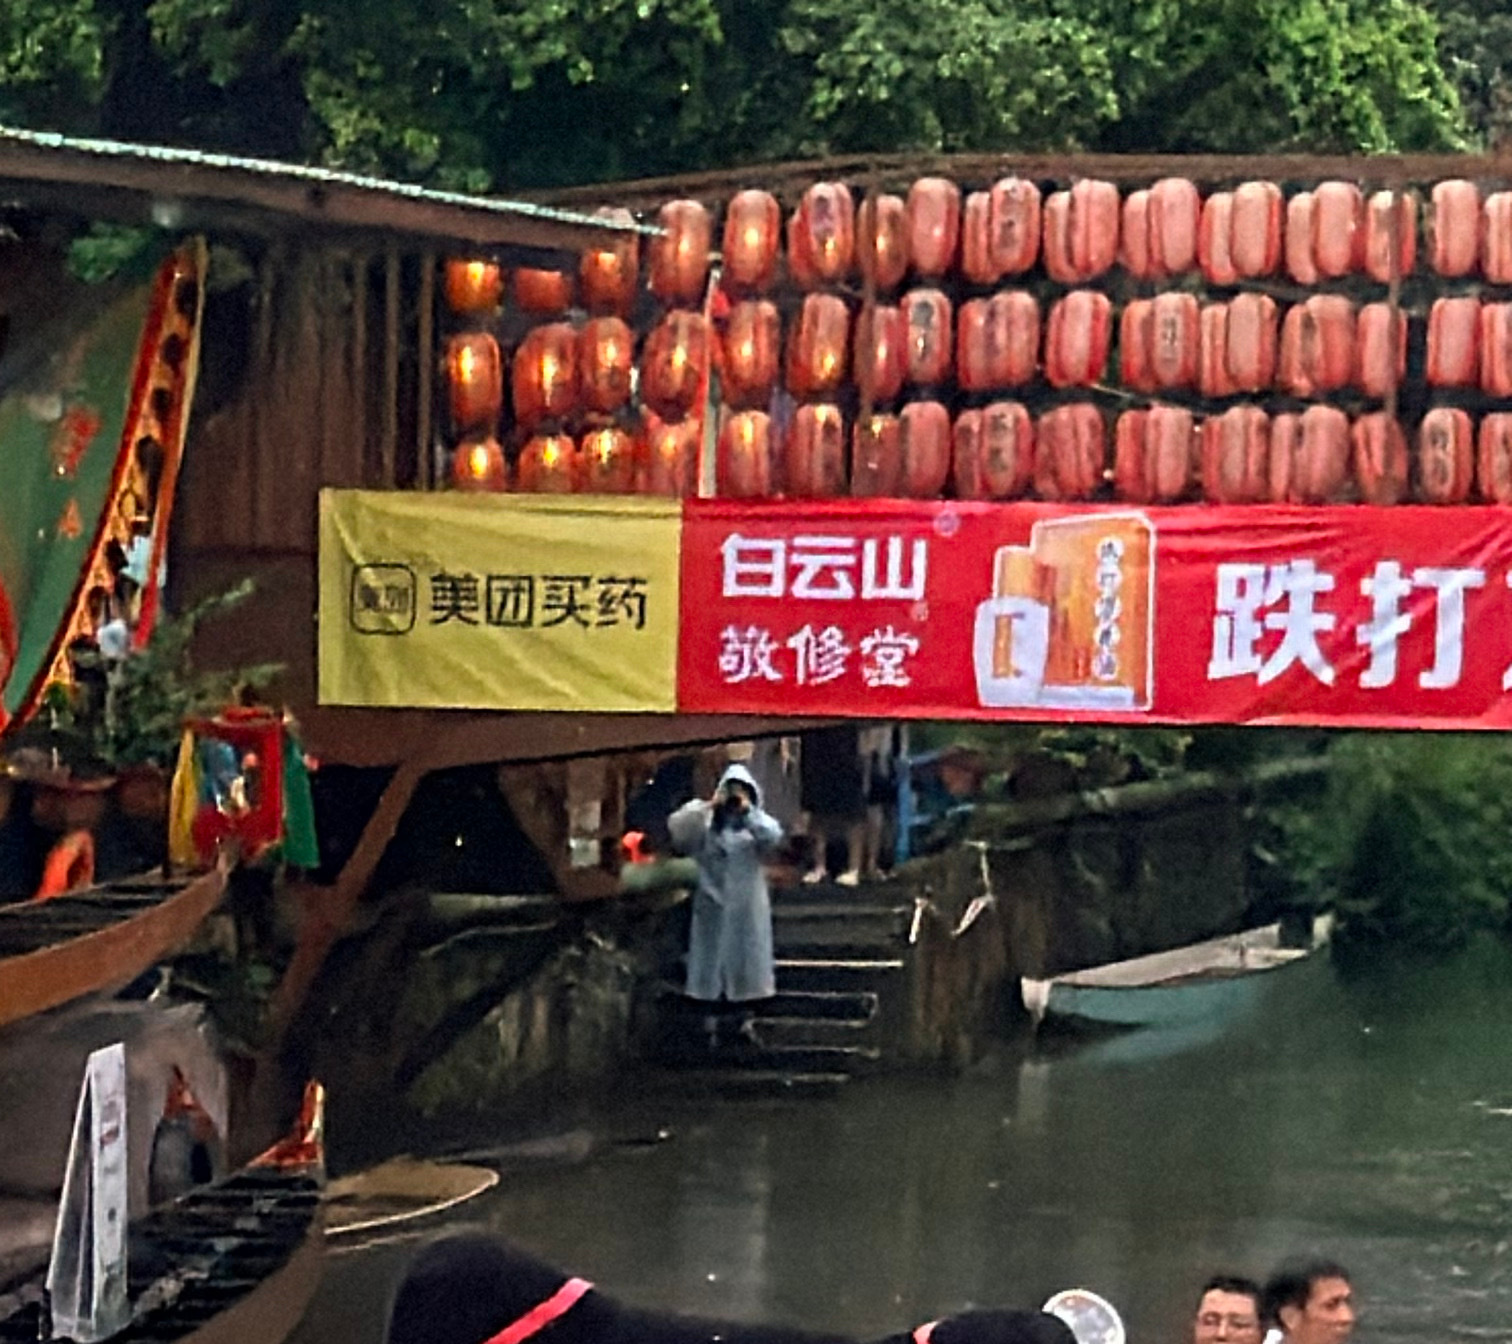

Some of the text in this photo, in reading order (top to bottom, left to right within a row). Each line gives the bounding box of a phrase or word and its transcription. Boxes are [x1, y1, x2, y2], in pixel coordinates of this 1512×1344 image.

[721, 533, 928, 600] 白云山
[430, 570, 648, 629] 美团买药
[1207, 558, 1512, 692] 跌打
[719, 624, 920, 687] 敬修堂
